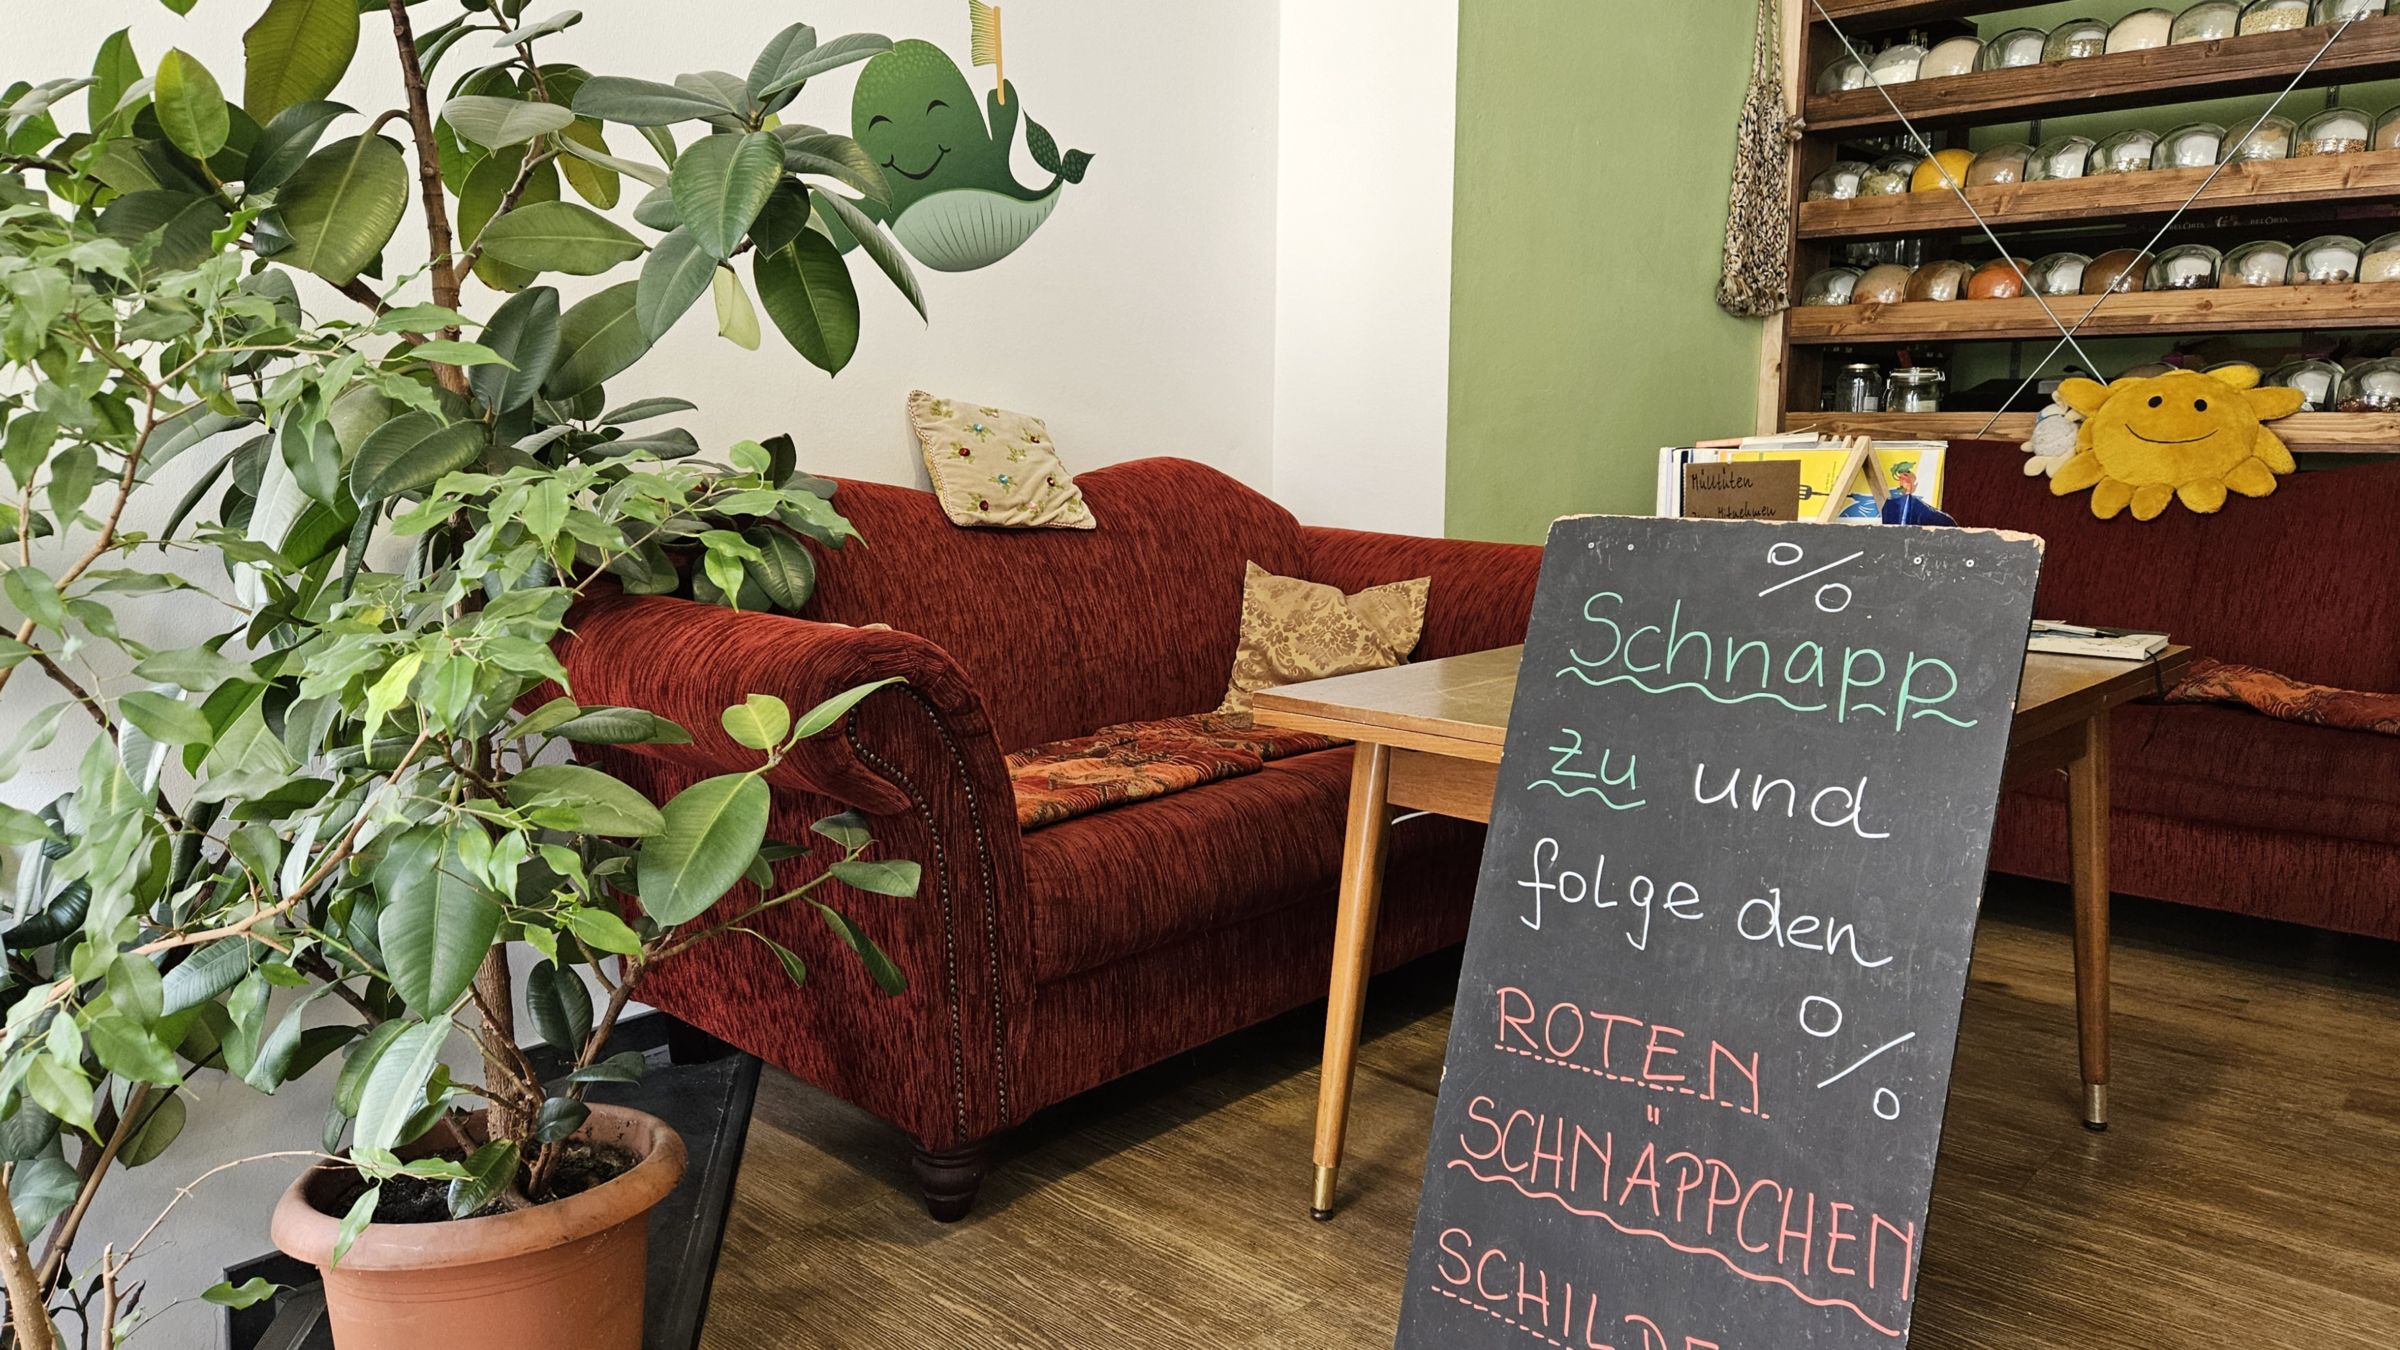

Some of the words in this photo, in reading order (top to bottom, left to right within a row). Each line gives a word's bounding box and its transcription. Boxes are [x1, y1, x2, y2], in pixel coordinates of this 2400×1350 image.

[1690, 467, 1754, 492] Mülltüten
[1758, 541, 1865, 613] %
[1569, 591, 1959, 733] Schnapp
[1548, 727, 1637, 791] zu
[1694, 762, 1891, 839] und
[1517, 837, 1704, 951] folge
[1736, 887, 1894, 968] den
[1496, 986, 1759, 1116] ROTEN
[1798, 995, 1916, 1121] %
[1459, 1095, 1917, 1302] SCHNÄPPCHEN
